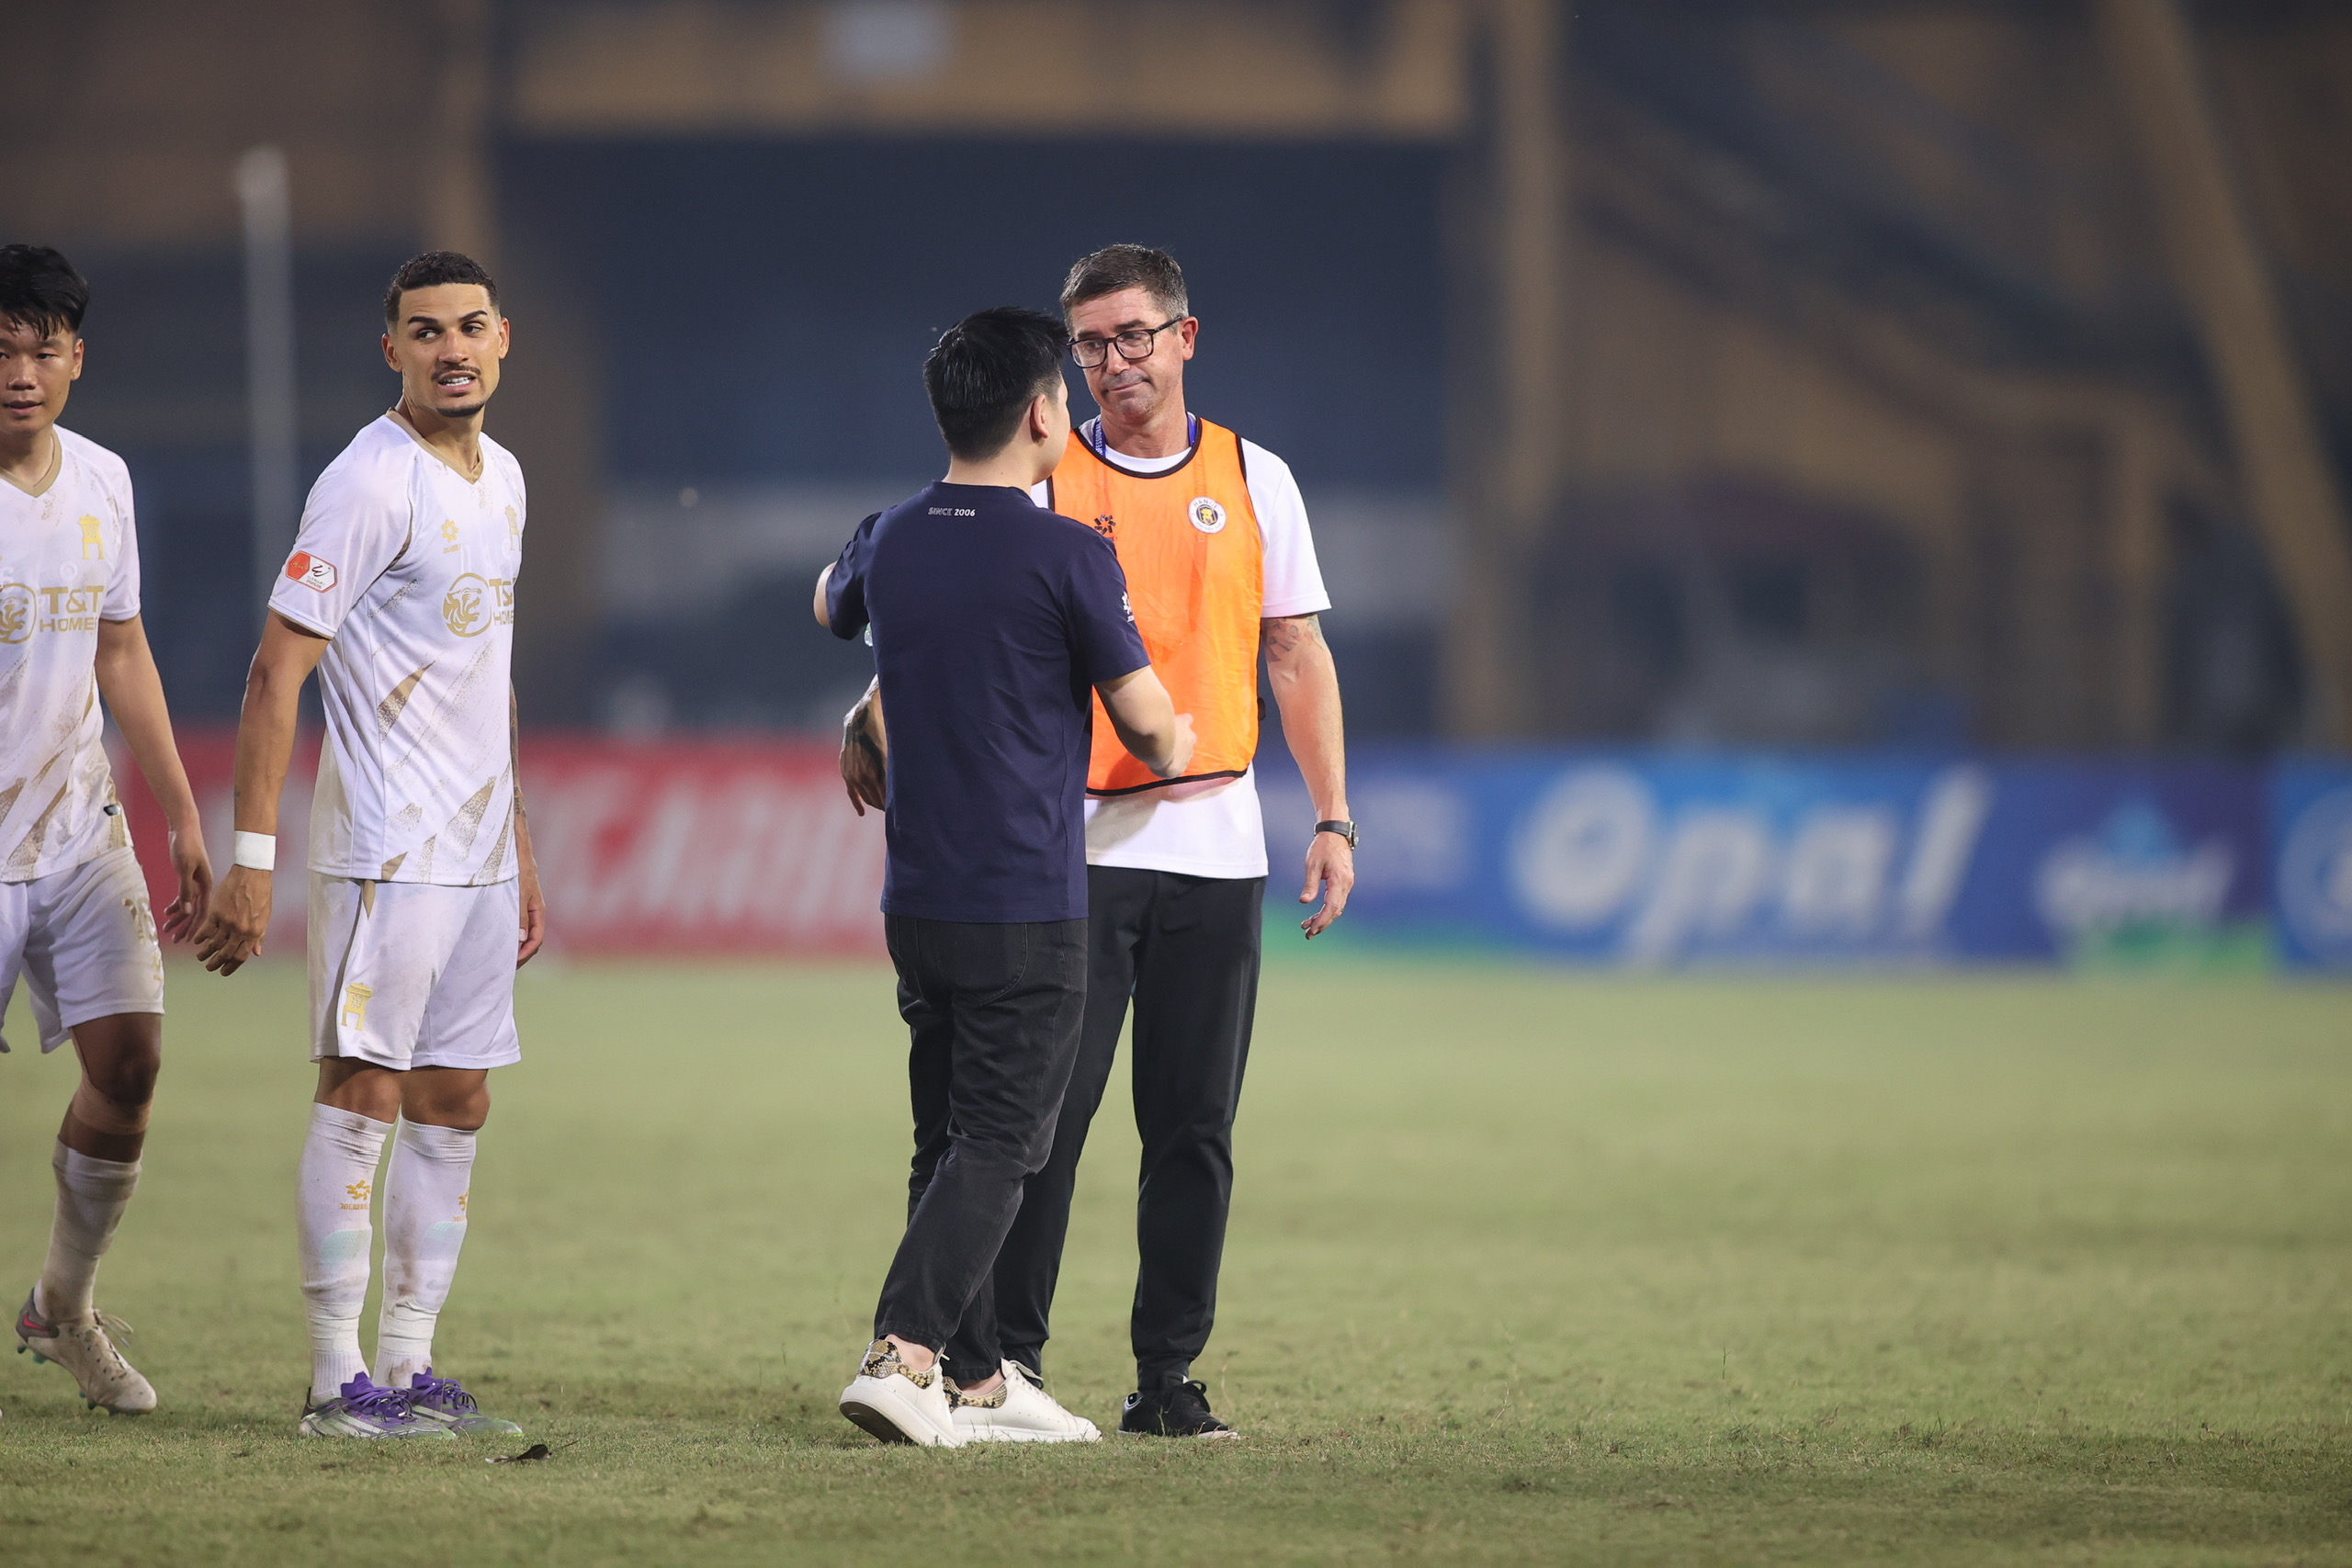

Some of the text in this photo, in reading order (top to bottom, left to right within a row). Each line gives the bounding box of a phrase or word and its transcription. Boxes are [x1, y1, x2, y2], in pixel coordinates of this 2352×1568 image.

[928, 506, 976, 517] SINCE 2006
[40, 585, 105, 615] T&T
[39, 616, 97, 633] HOME
